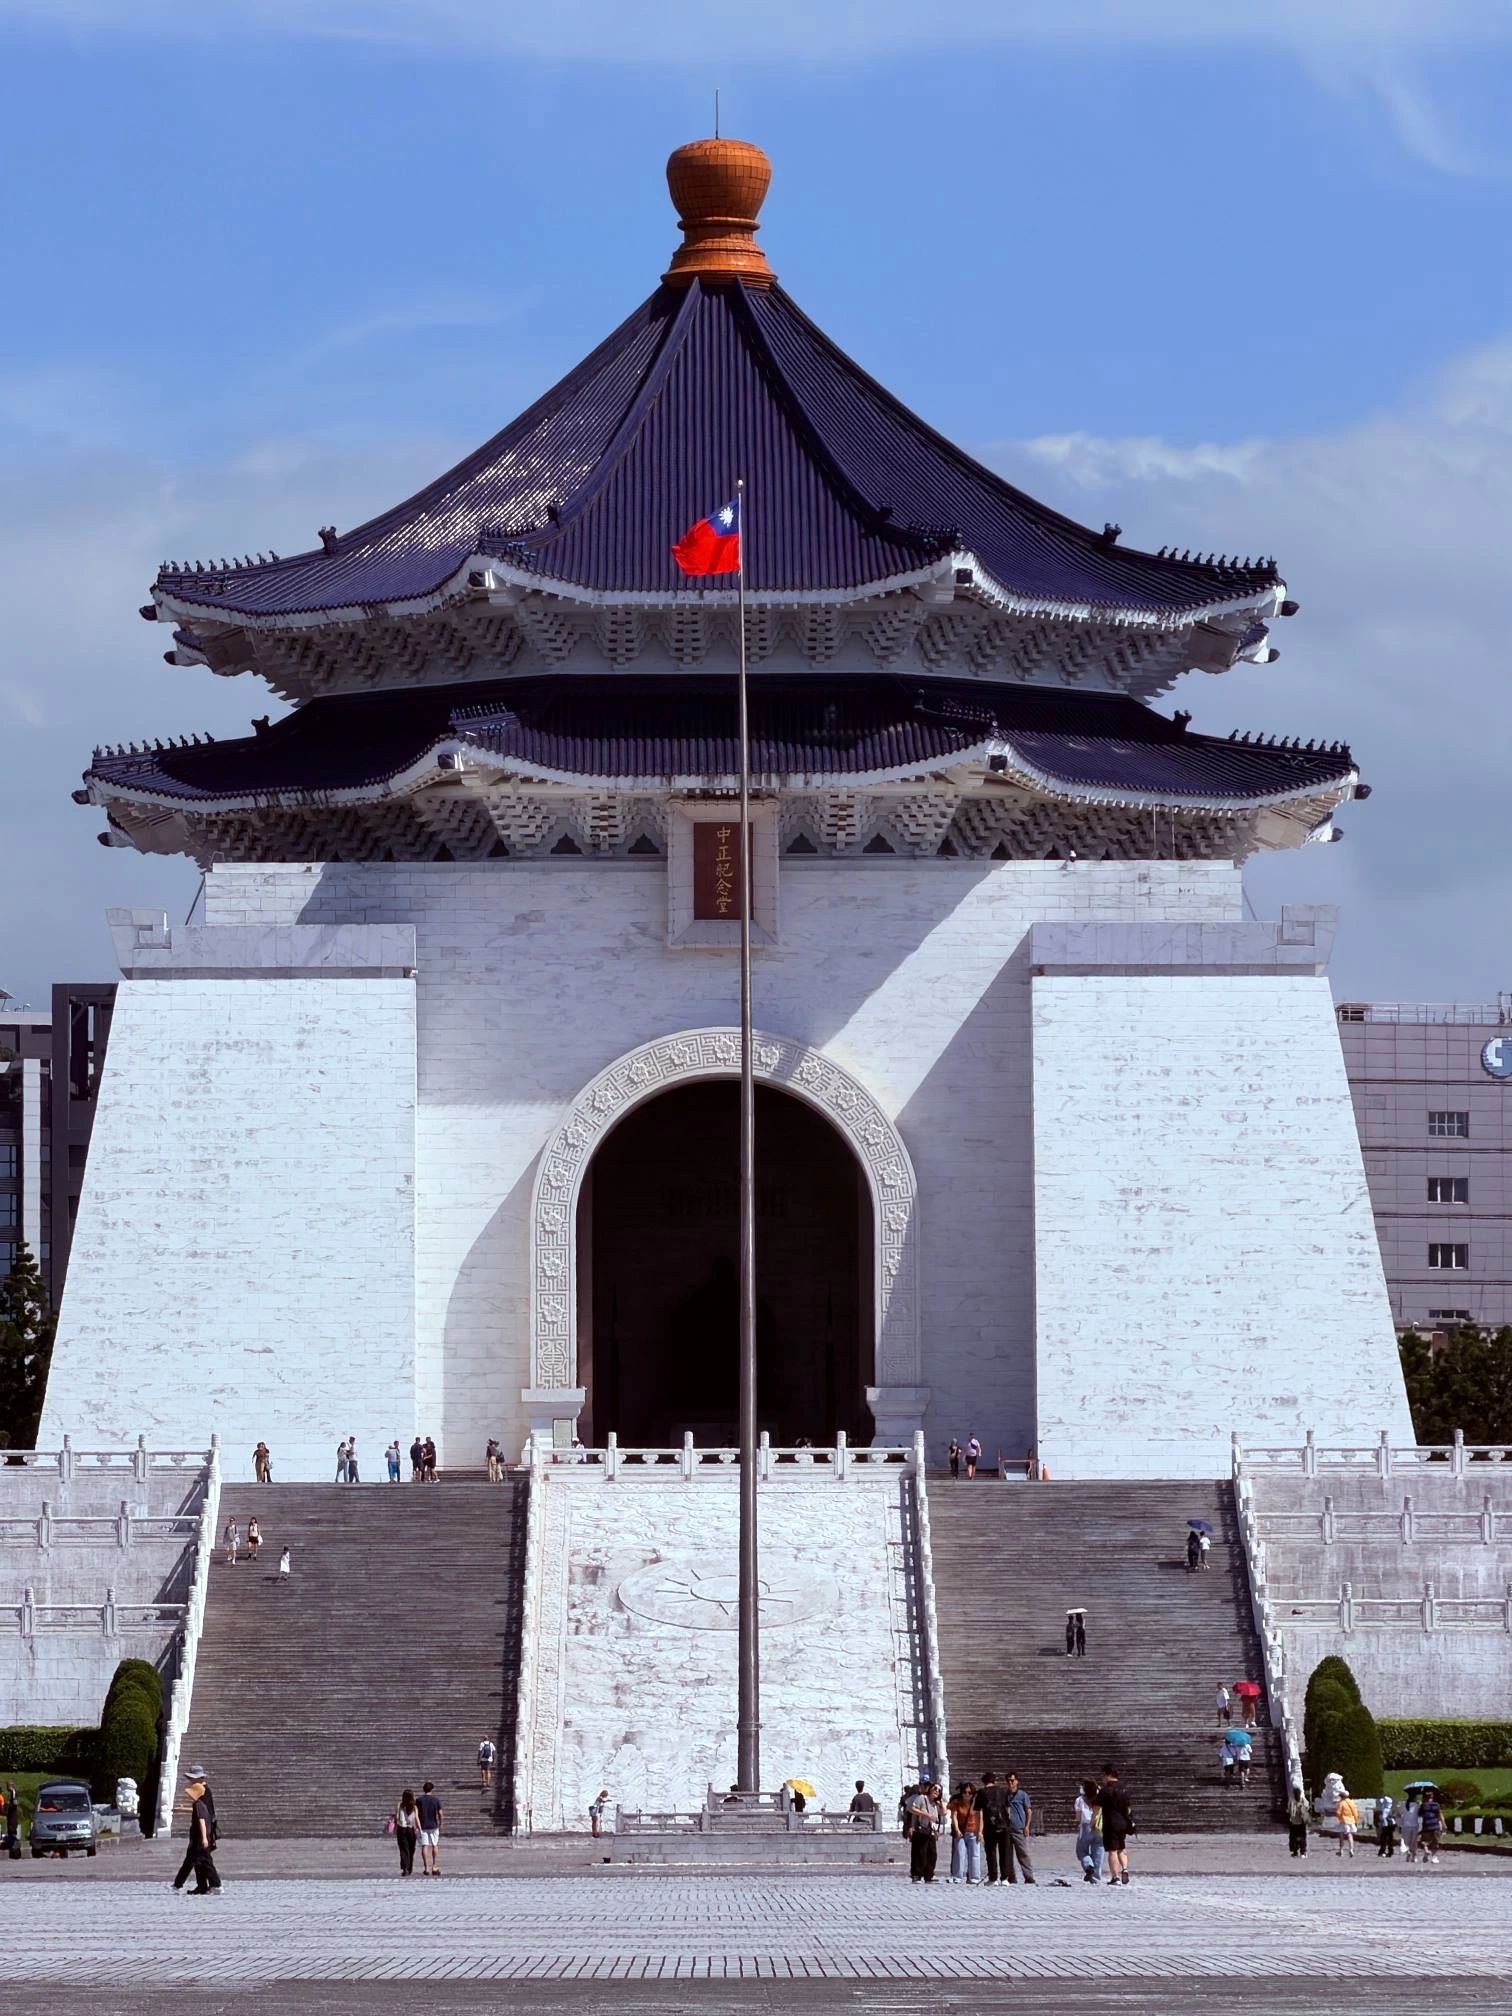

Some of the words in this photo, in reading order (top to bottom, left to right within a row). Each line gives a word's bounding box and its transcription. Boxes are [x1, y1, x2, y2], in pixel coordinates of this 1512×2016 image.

[715, 825, 734, 913] 中正紀念堂
